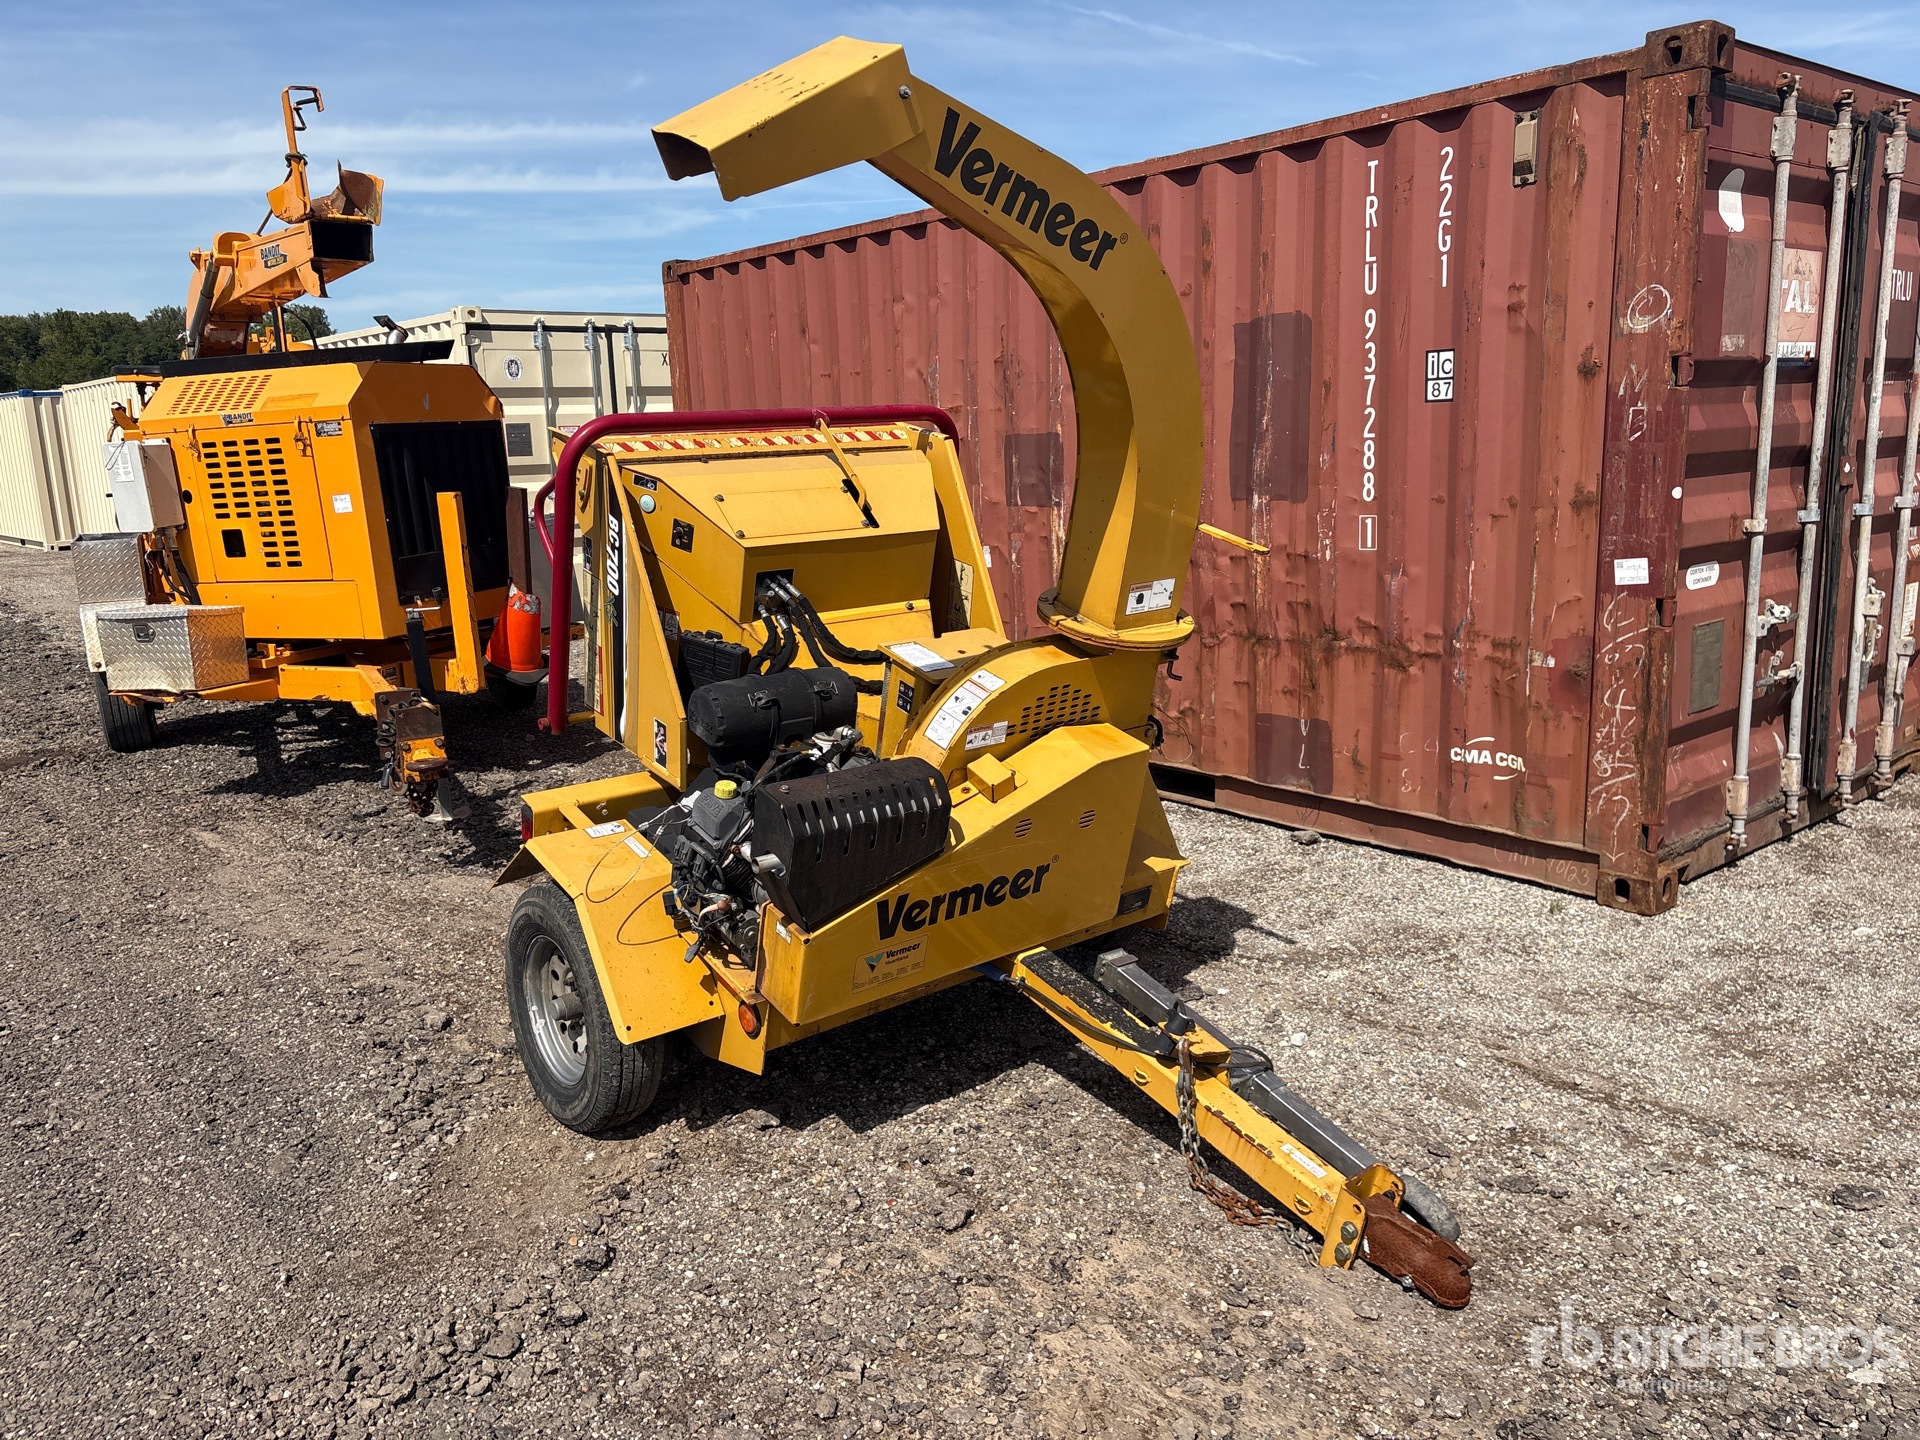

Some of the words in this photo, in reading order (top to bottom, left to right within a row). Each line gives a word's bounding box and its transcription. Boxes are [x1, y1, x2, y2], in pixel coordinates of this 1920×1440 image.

[934, 106, 1118, 271] Vermeer
[1364, 160, 1379, 295] TRLU
[1436, 146, 1454, 287] 22G1
[260, 244, 281, 260] BANDIT
[1891, 269, 1913, 301] TRLU
[1362, 308, 1377, 502] 937288
[1431, 381, 1452, 398] 87
[1364, 517, 1374, 549] 1
[606, 514, 619, 596] BC700
[1693, 575, 1712, 585] CONTAINER
[1450, 747, 1493, 765] CMA
[877, 862, 1051, 941] Vermeer
[885, 942, 921, 959] Vermeer
